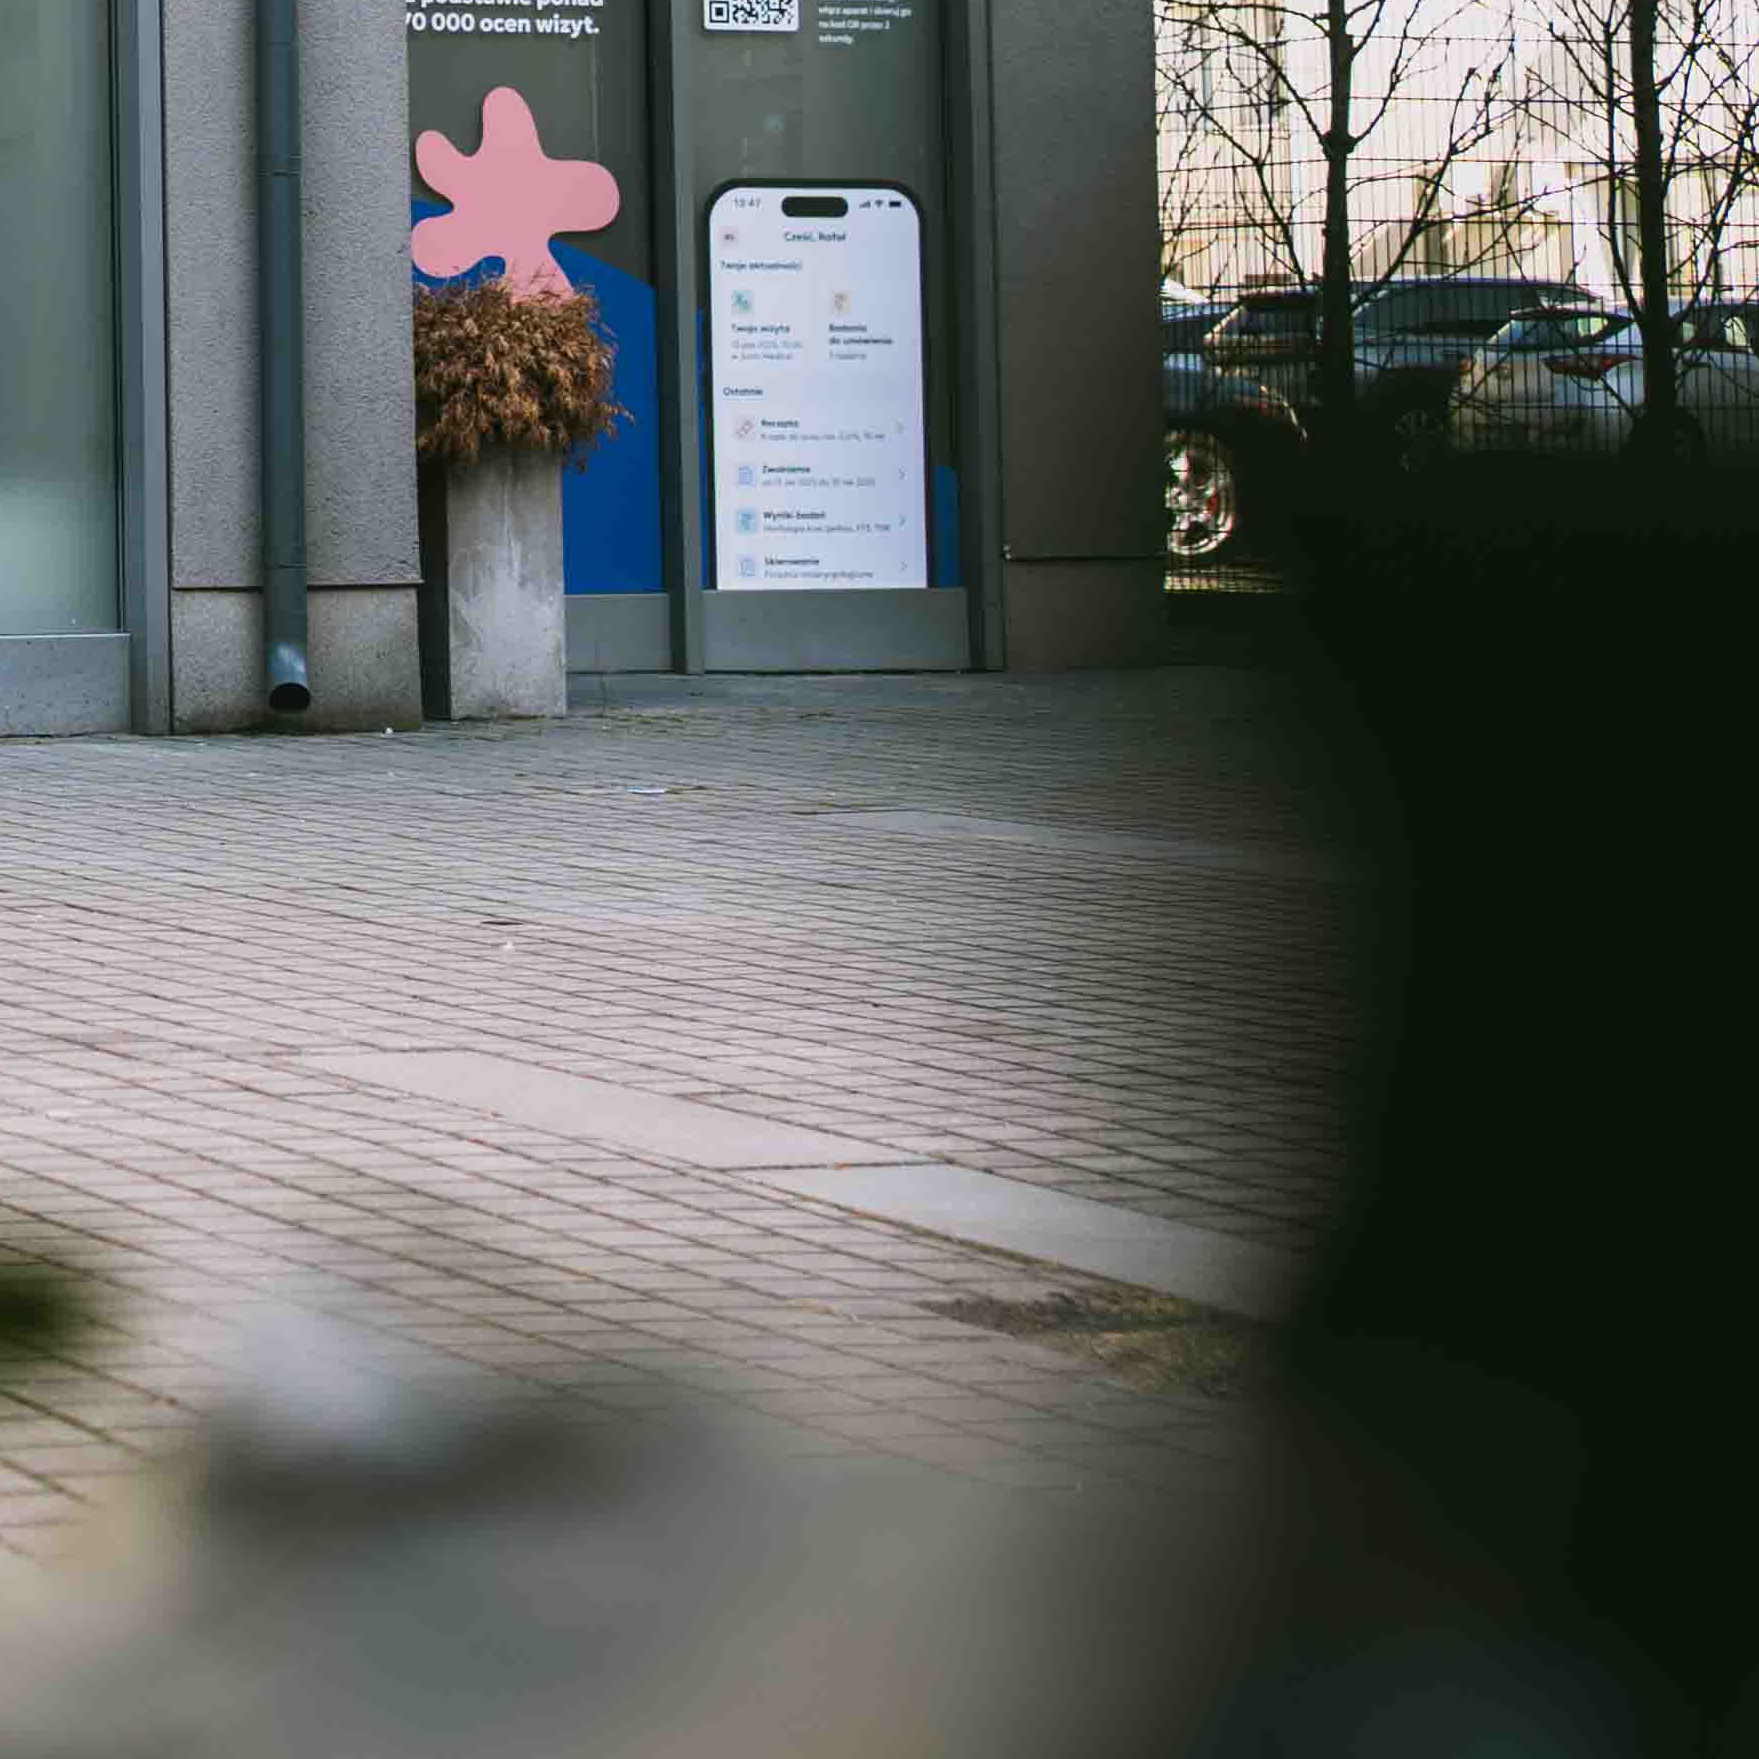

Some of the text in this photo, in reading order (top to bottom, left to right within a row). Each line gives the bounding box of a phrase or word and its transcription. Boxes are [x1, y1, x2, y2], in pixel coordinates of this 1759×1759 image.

[432, 14, 474, 32] 000
[480, 17, 530, 33] ocen
[536, 14, 599, 38] wizyt.
